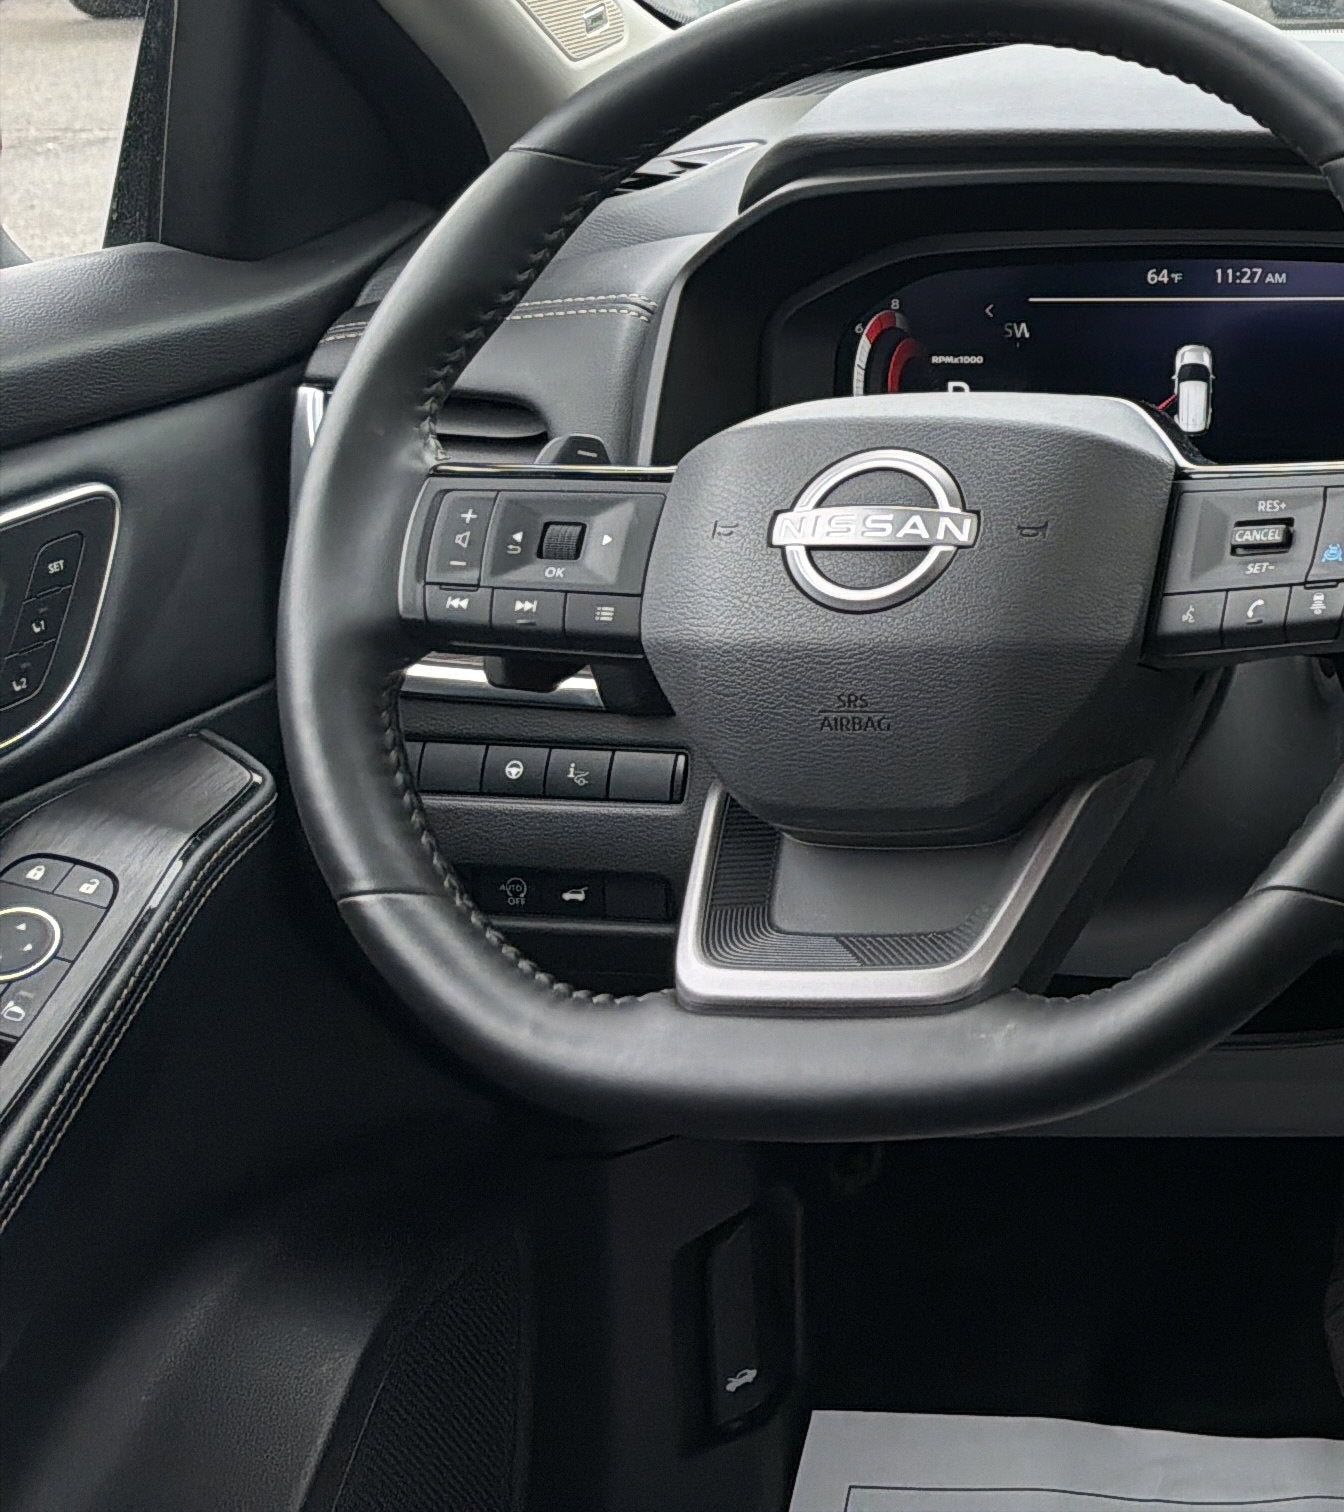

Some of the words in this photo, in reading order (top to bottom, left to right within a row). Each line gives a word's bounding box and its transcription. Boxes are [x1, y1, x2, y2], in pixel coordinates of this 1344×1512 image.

[1215, 267, 1262, 284] 11:27
[1265, 271, 1287, 284] AM
[890, 299, 900, 310] 8
[854, 322, 864, 334] 6
[1257, 499, 1287, 512] RES+
[780, 513, 972, 542] NISSAN
[1235, 528, 1281, 542] CANCEL
[47, 559, 65, 574] SET
[544, 566, 566, 578] OK
[836, 693, 869, 709] SRS
[819, 716, 891, 732] AIRBAG
[507, 897, 526, 906] OFF
